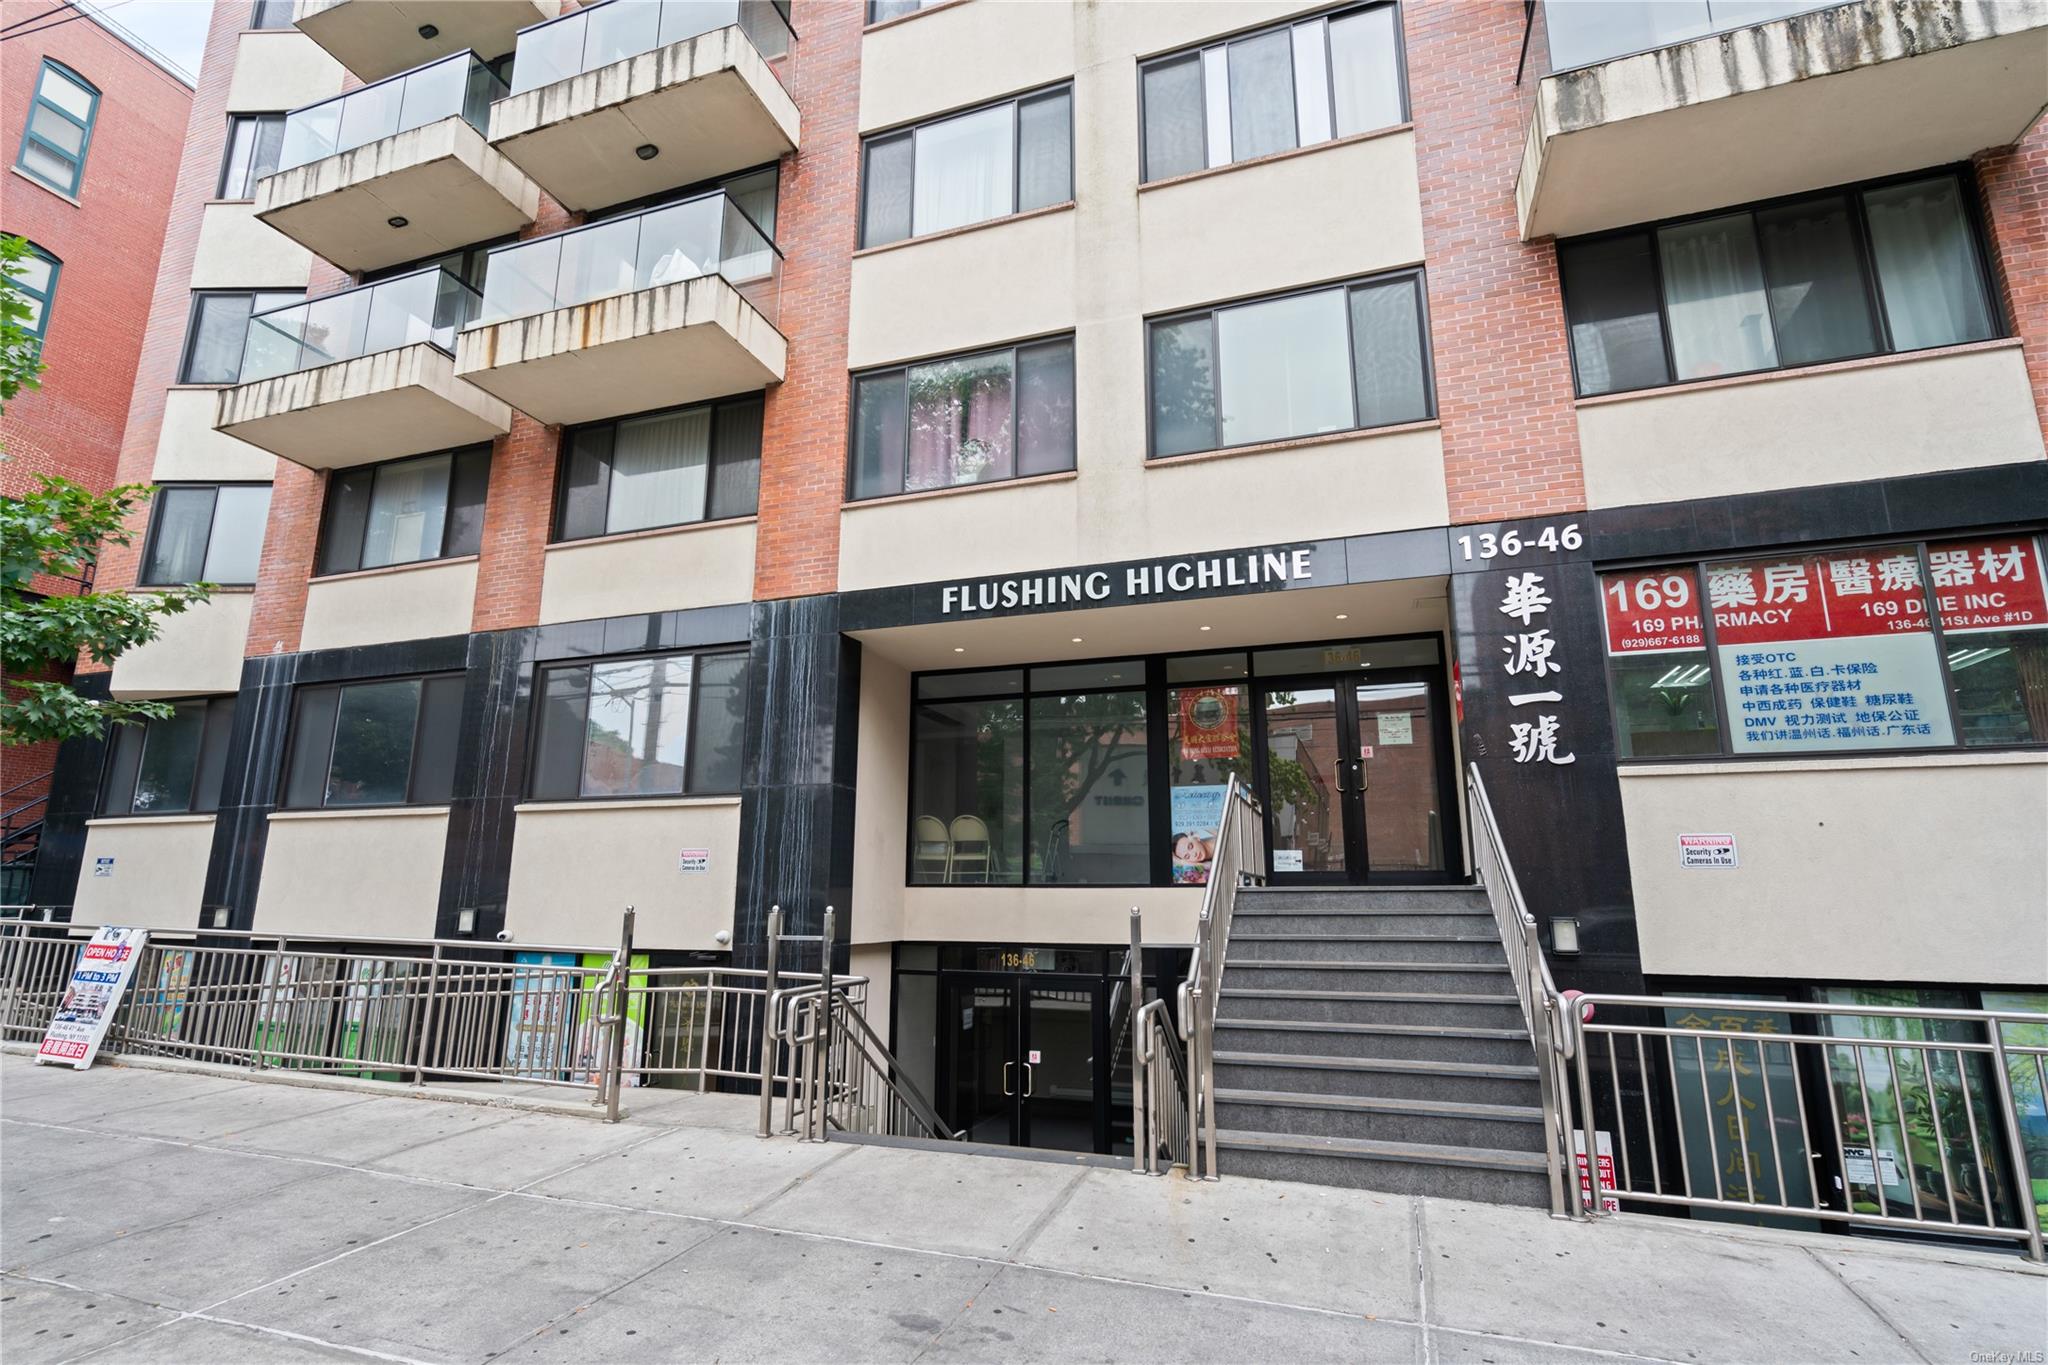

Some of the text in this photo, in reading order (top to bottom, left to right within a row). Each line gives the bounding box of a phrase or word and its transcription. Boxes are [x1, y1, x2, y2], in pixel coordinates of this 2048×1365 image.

[1458, 524, 1583, 561] 136-46
[1829, 545, 2027, 597] 醫療器材
[942, 549, 1312, 613] FLUSHING HIGHLINE
[1706, 563, 1810, 608] 藥房
[1608, 575, 1690, 612] 169
[1860, 602, 1898, 617] 169
[1965, 592, 2007, 610] INC
[1632, 608, 1793, 634] 169 PHRMACY
[1973, 614, 2001, 625] Ave
[2003, 610, 2033, 623] #1D
[1621, 634, 1700, 649] (929)667-6188
[1498, 571, 1576, 765] 華源一號
[1735, 652, 1797, 666] 接受OTC
[1740, 679, 1862, 697] 申请各种医疗器材
[1742, 698, 1803, 713] 中西成药
[1744, 709, 1921, 727] DMV 视力测试 地保公证
[1685, 847, 1712, 857] Security
[1686, 856, 1712, 865] Cameras
[1720, 856, 1732, 865] Use
[87, 947, 130, 960] OPEN HOSE
